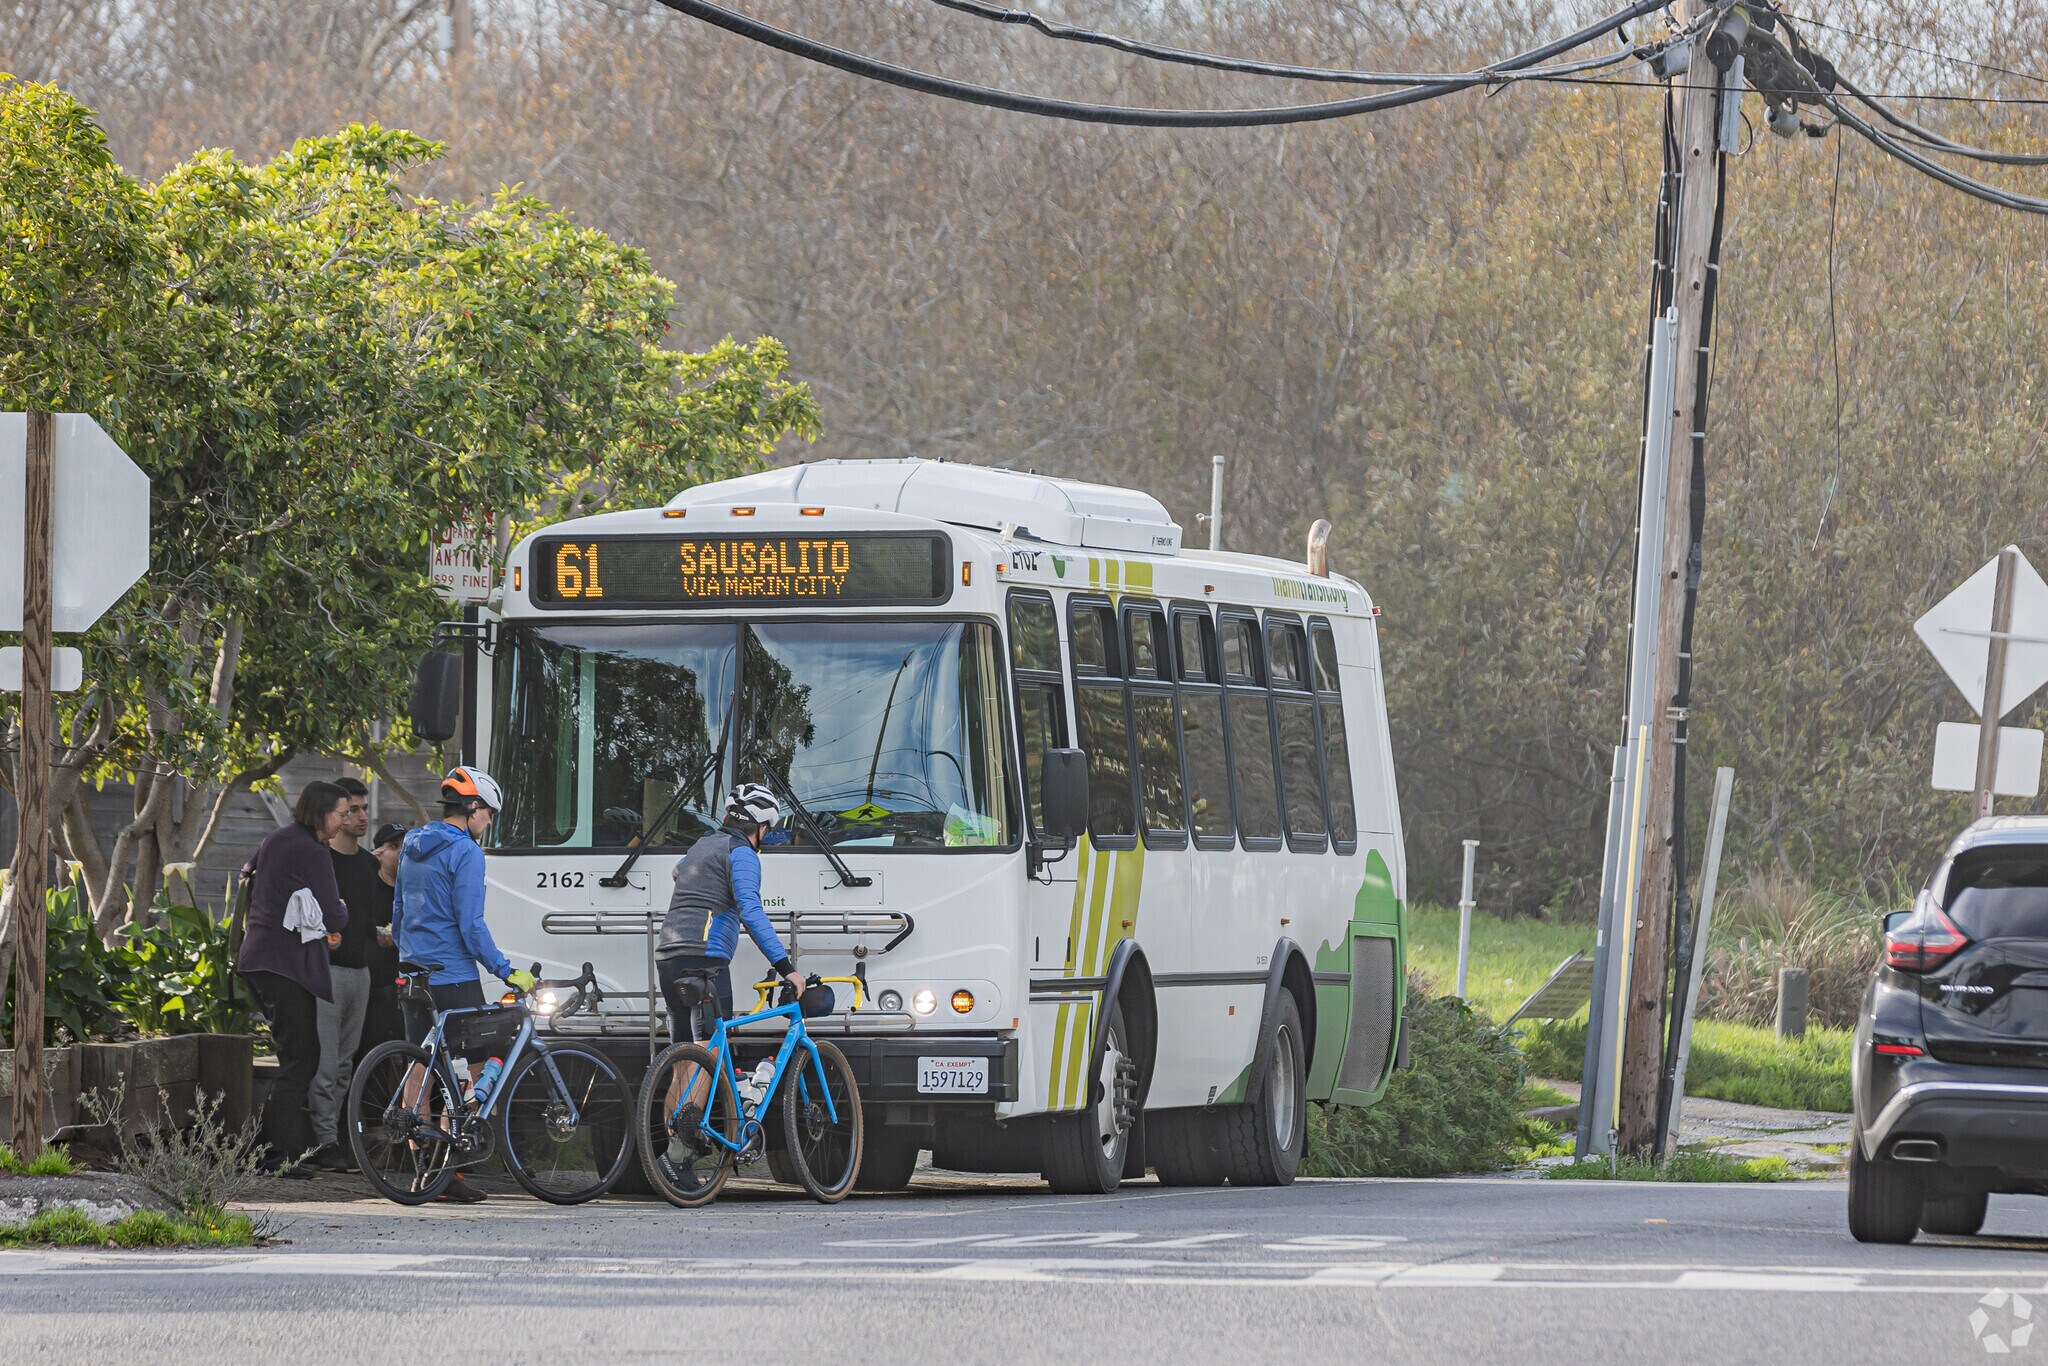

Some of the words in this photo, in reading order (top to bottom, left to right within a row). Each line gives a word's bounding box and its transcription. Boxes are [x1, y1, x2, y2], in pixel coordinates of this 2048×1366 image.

[435, 548, 488, 568] ANYTIE
[556, 543, 603, 599] 61
[680, 541, 850, 575] SAUSALITO
[434, 573, 454, 586] $99
[462, 574, 488, 588] FINE
[682, 576, 721, 596] VIA
[724, 576, 790, 597] MARIN
[794, 576, 847, 596] CITY
[536, 871, 585, 889] 2162
[763, 896, 786, 907] nsit
[1939, 984, 1994, 994] MURANO
[922, 1071, 983, 1088] 1597129
